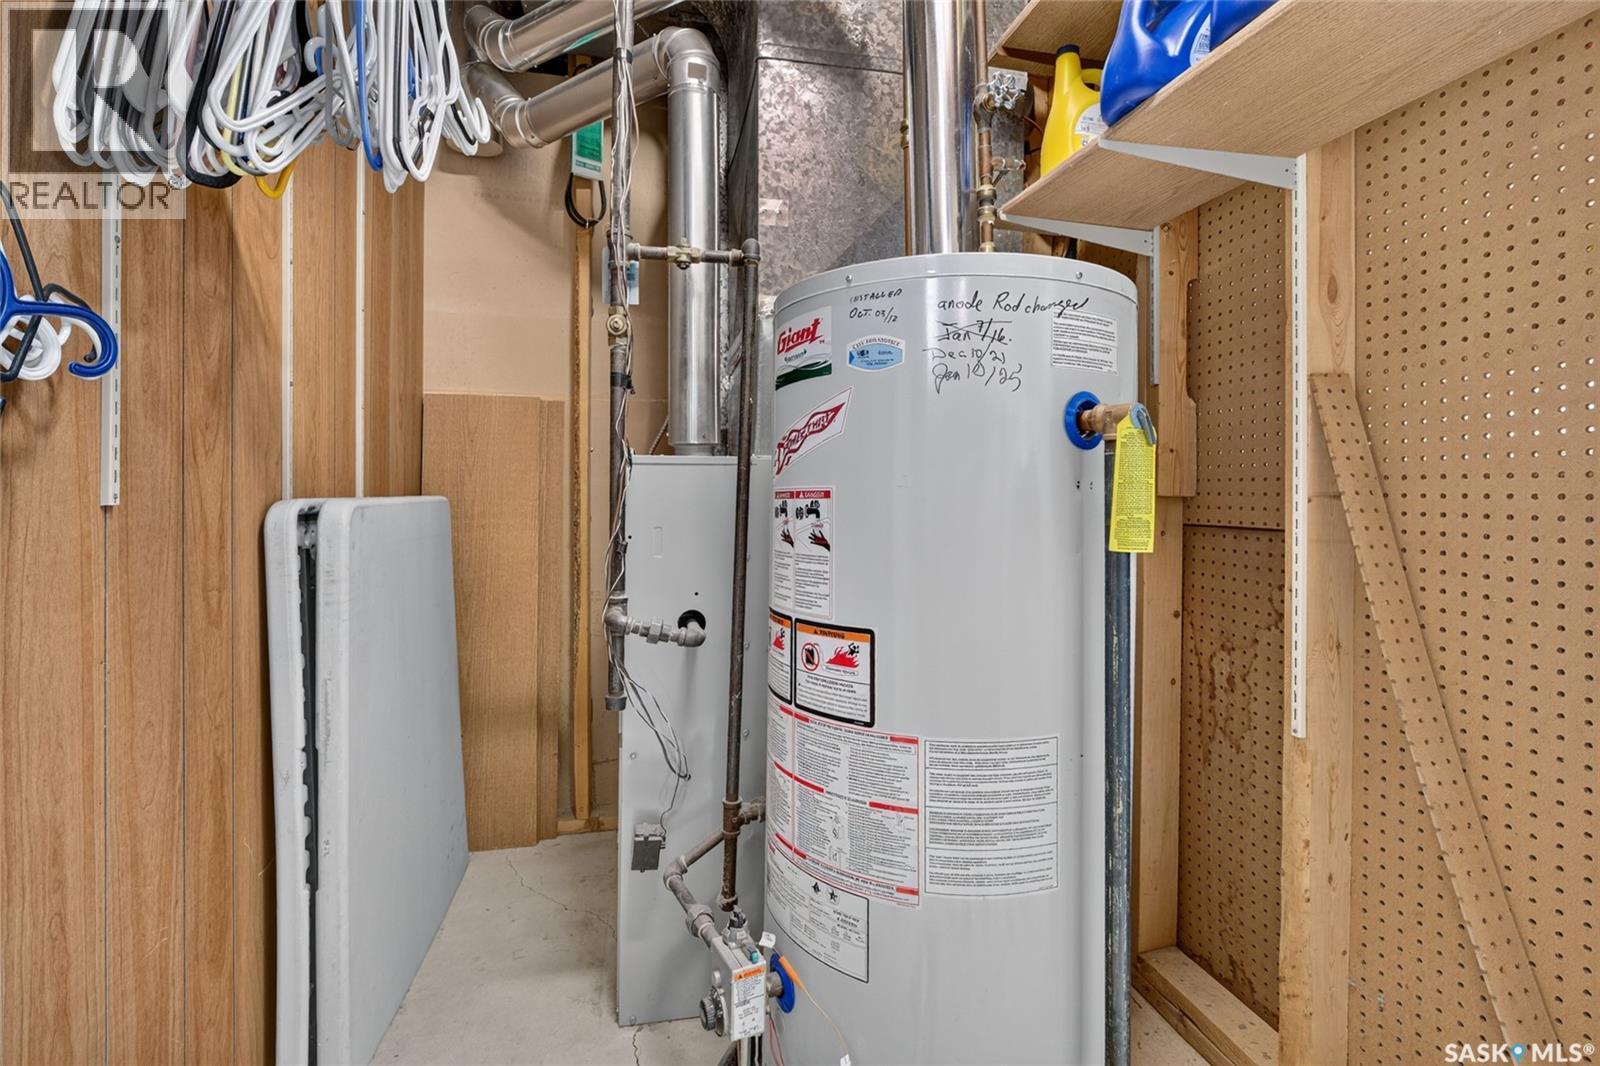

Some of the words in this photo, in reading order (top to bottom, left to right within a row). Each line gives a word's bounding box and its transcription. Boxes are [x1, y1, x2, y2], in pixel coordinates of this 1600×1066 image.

[850, 288, 903, 303] INSTALLED
[993, 291, 1026, 313] Rod
[777, 317, 823, 355] Giant
